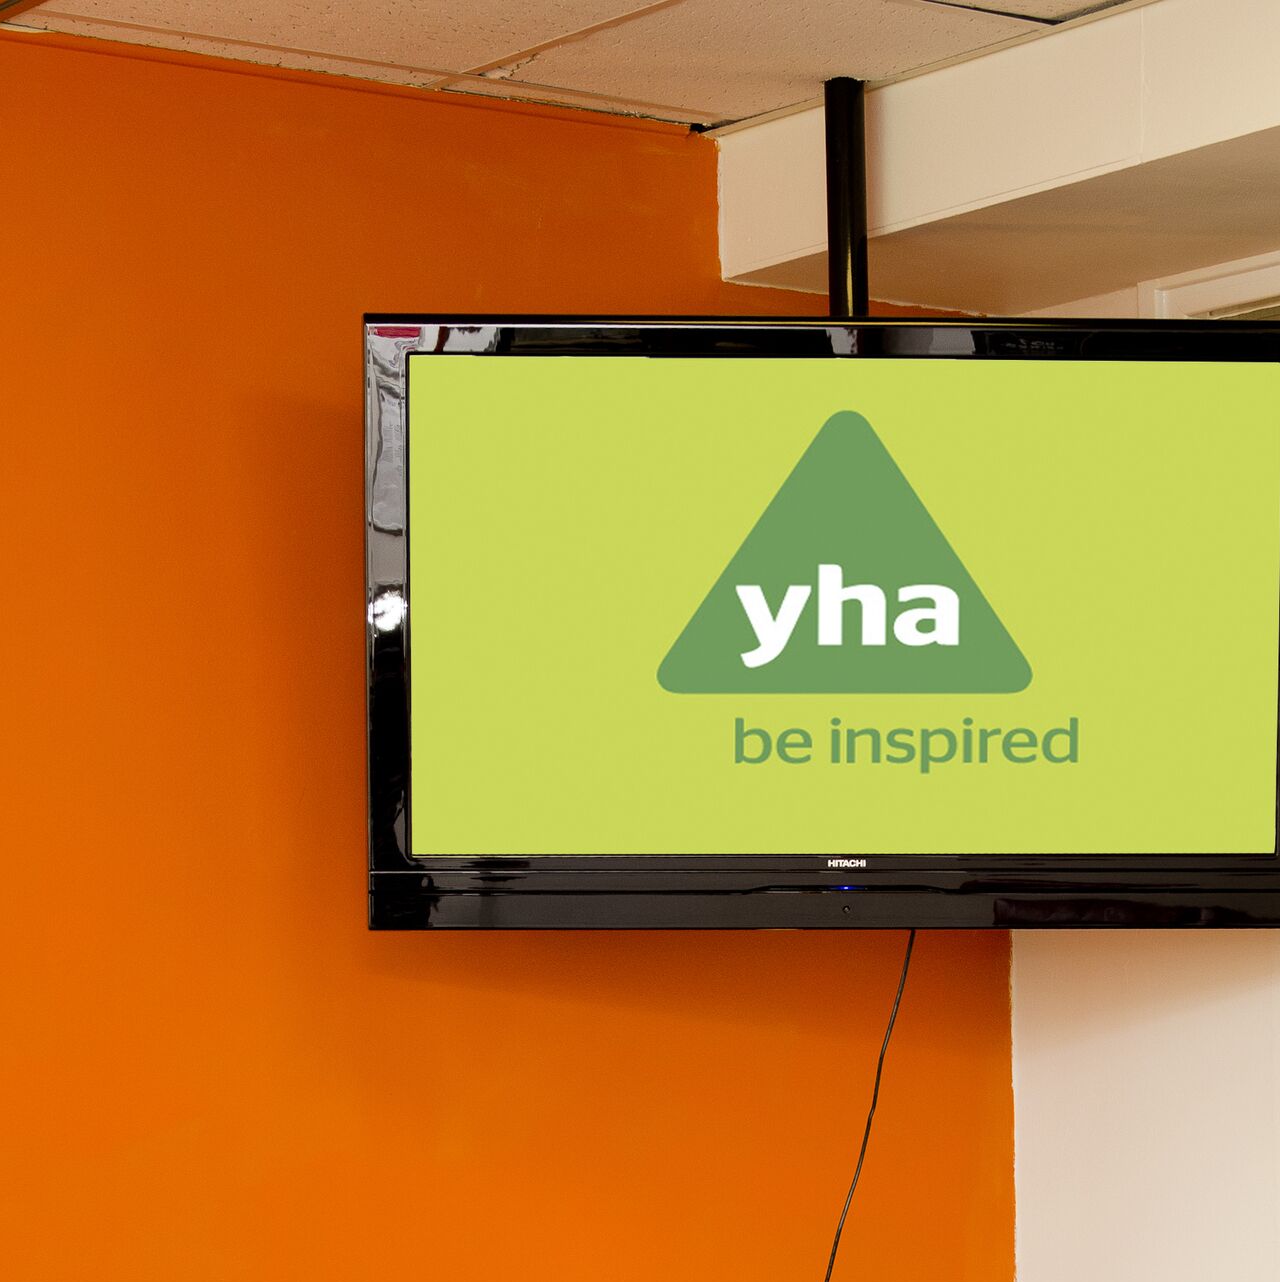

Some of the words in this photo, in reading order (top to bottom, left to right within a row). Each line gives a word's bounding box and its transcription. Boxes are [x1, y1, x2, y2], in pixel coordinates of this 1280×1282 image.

[735, 563, 960, 669] yha
[734, 717, 813, 764] be
[830, 717, 1079, 774] inspired
[827, 859, 867, 867] HITACHI
